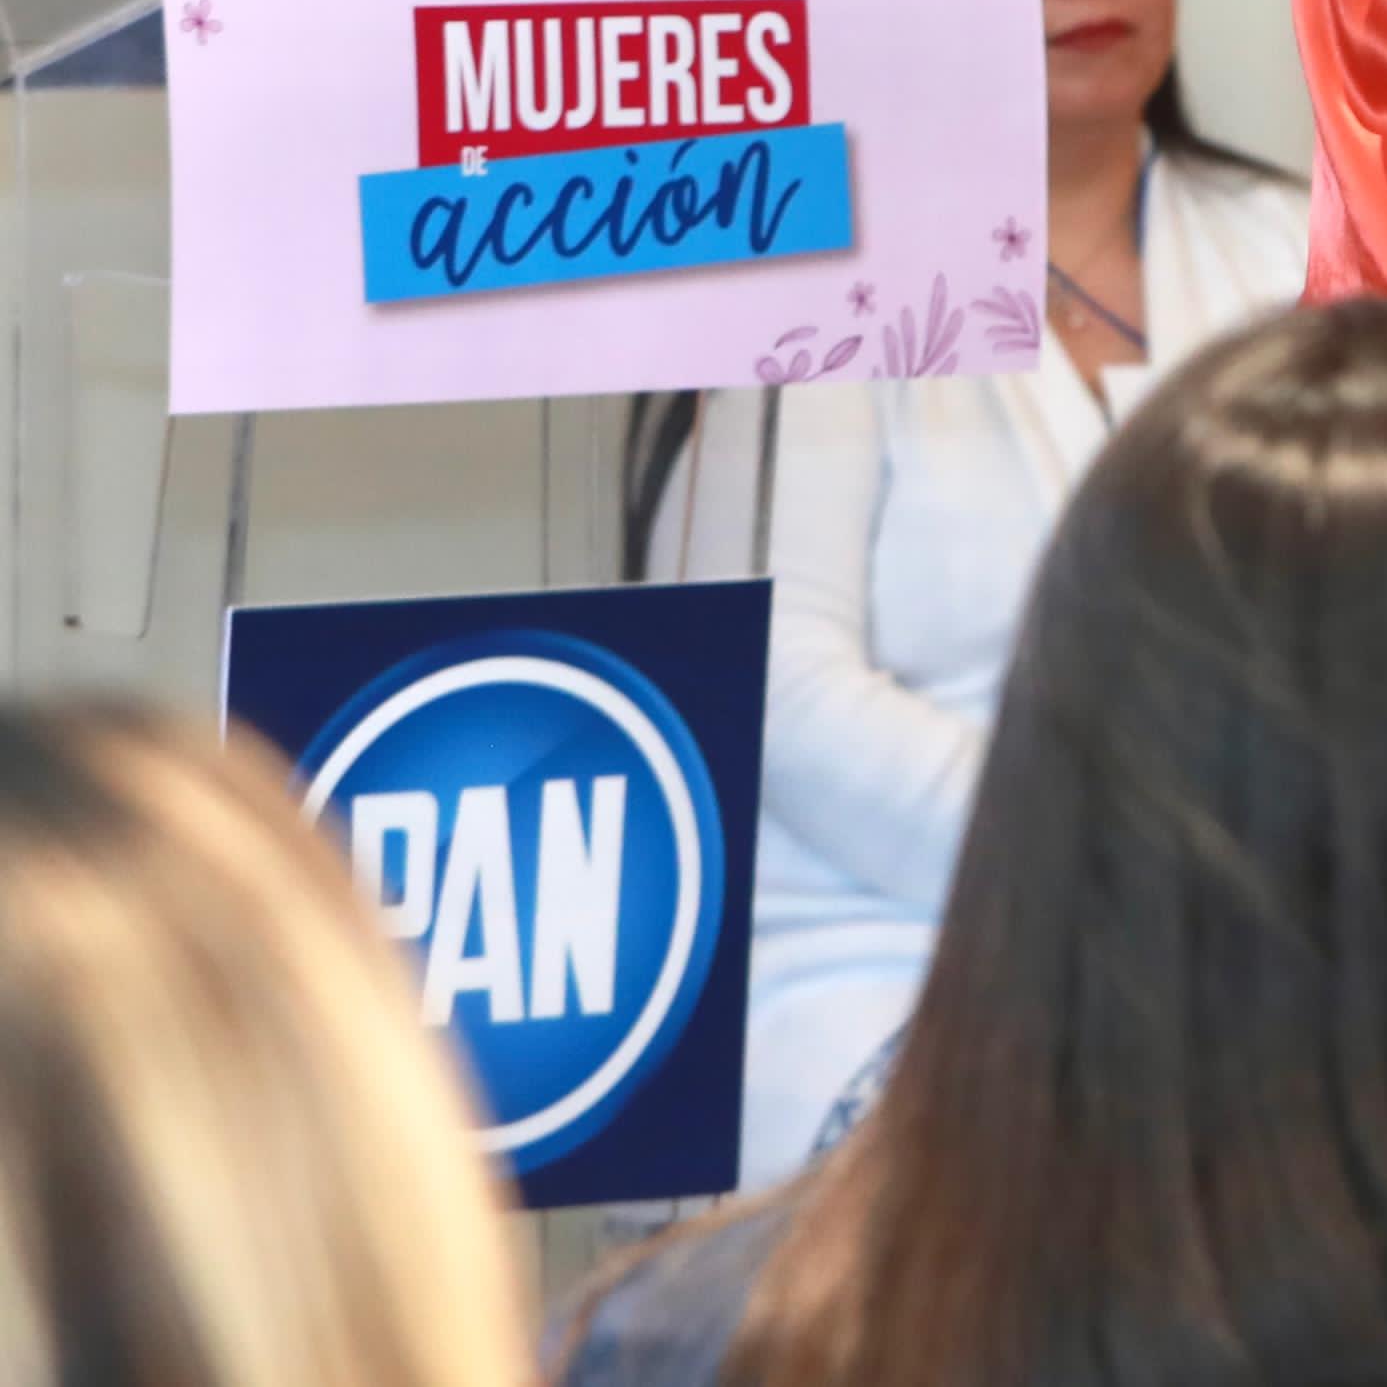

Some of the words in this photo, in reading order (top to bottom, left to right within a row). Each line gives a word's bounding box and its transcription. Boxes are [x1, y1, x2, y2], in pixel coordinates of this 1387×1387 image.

[443, 12, 793, 132] MUJERES
[410, 140, 801, 287] acción
[460, 145, 489, 176] DE
[352, 774, 627, 1027] PAN
